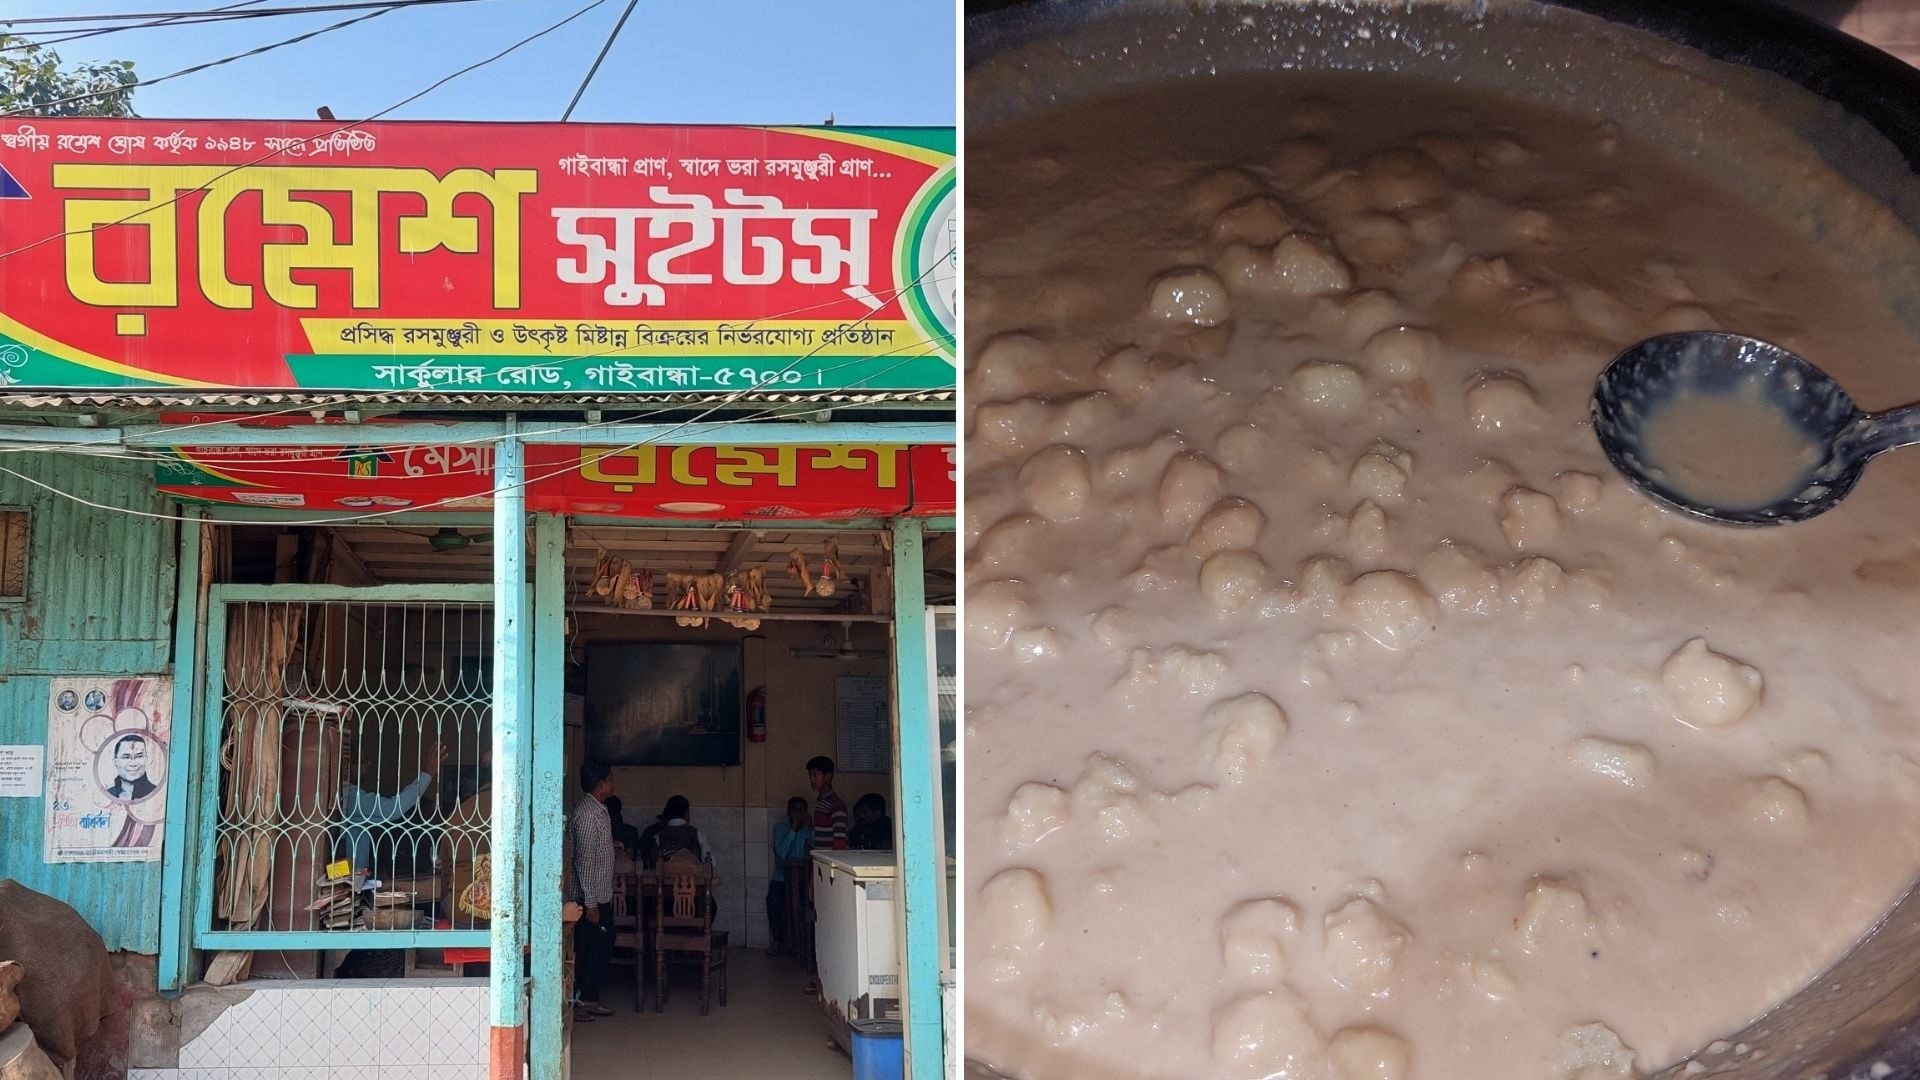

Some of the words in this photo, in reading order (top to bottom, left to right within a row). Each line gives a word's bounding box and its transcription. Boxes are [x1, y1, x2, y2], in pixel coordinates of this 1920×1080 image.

[57, 134, 101, 154] রমেশ
[108, 135, 146, 154] ঘোষ
[205, 136, 256, 151] ১৯৪৮
[264, 137, 306, 157] সালে
[558, 152, 629, 178] গাইবান্ধা
[633, 156, 673, 180] প্রাণ,
[679, 157, 721, 176] স্বাদে
[725, 158, 759, 177] ভরা
[53, 163, 538, 336] রমেশ
[551, 186, 884, 311] সুইটস্
[340, 321, 396, 345] প্রসিদ্ধ
[490, 328, 504, 344] ও
[512, 323, 569, 353] উৎকৃষ্ট
[576, 324, 630, 349] মিষ্টান্ন
[635, 324, 712, 346] বিক্রয়ের
[717, 323, 815, 346] নির্ভরযোগ্য
[821, 322, 895, 346] প্রতিষ্ঠান
[371, 358, 486, 389] সার্কুলার
[497, 365, 572, 390] রোড,
[404, 444, 494, 476] মেসা
